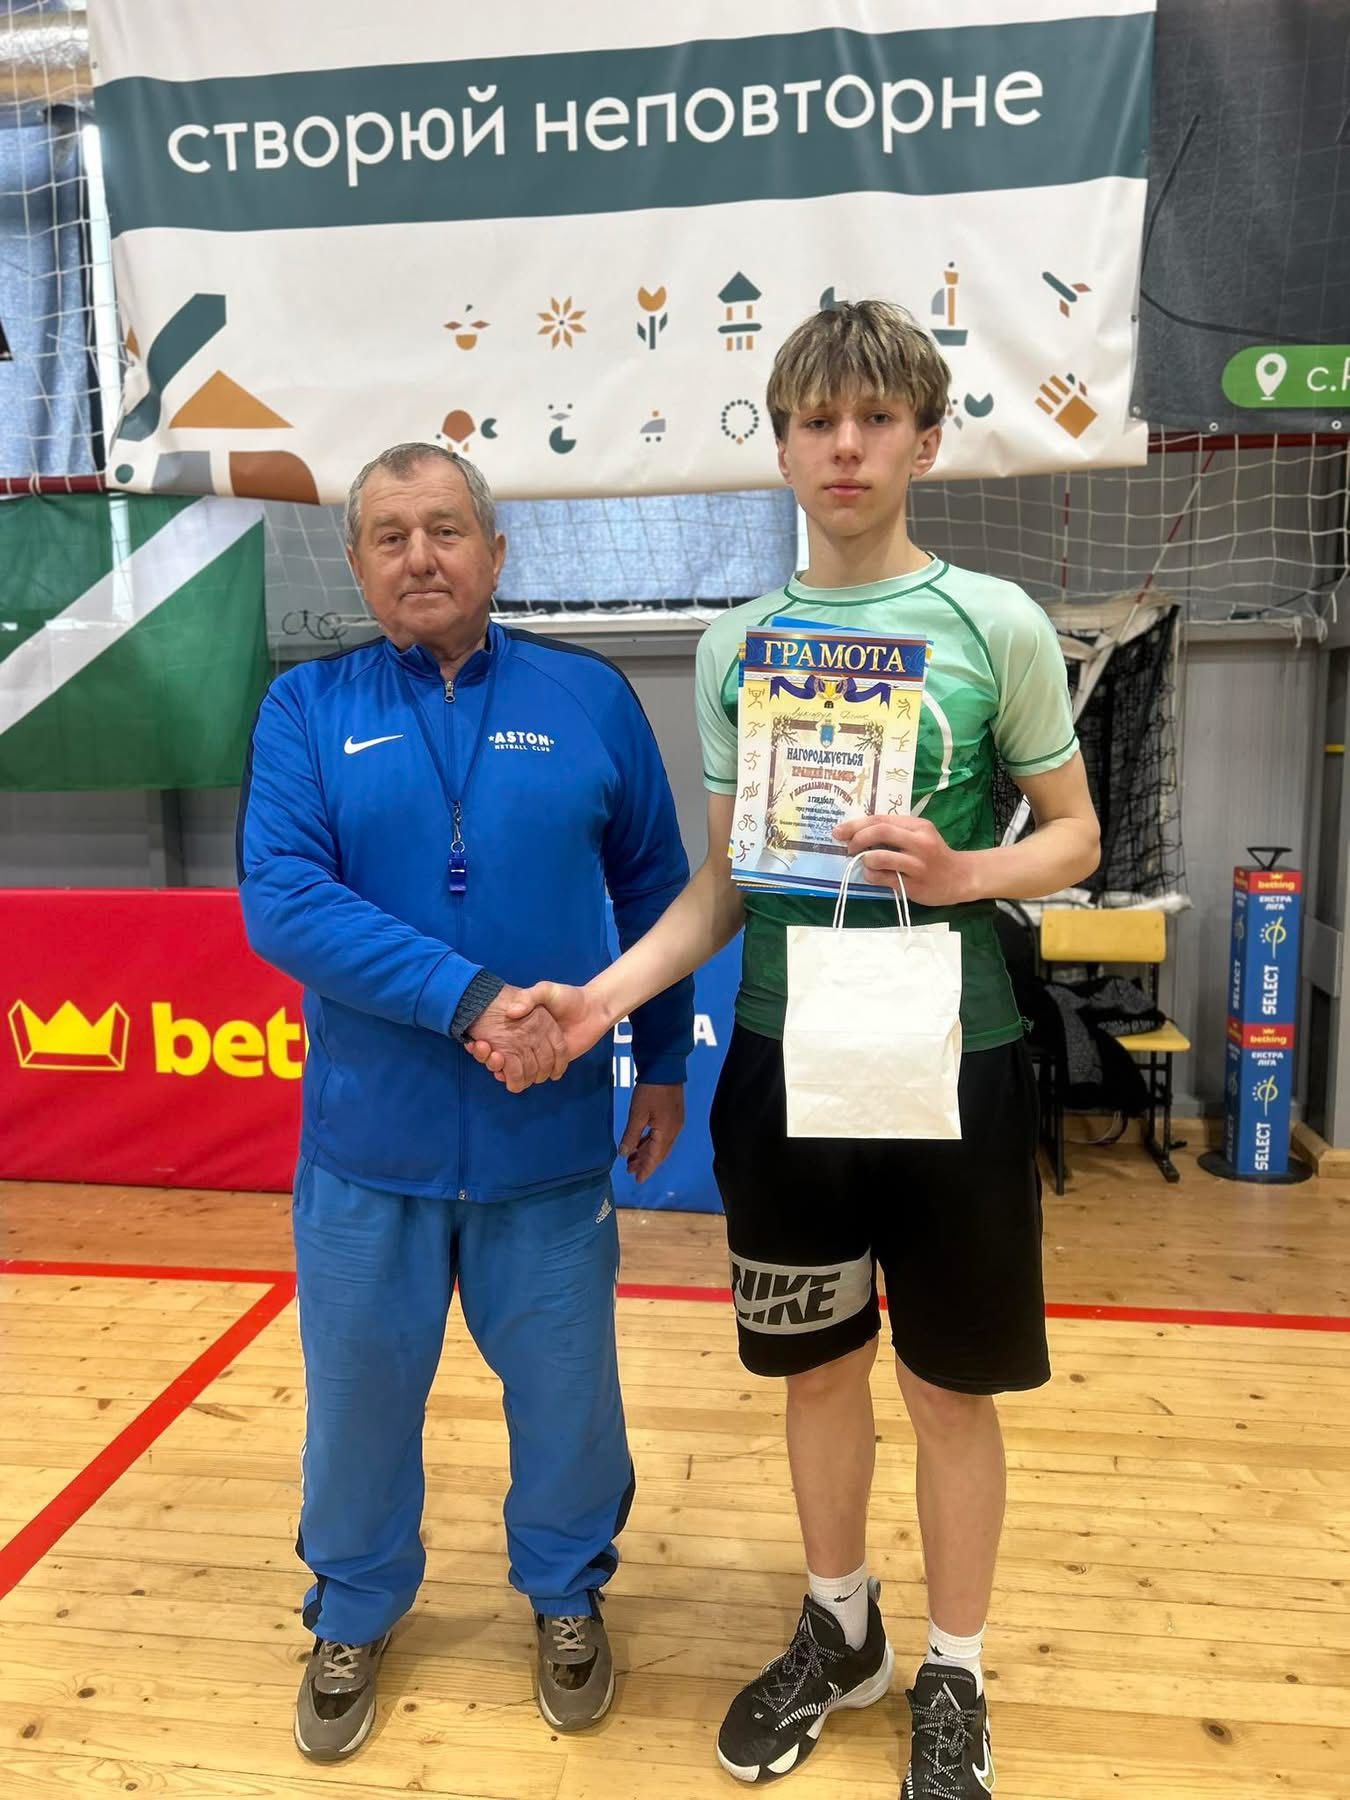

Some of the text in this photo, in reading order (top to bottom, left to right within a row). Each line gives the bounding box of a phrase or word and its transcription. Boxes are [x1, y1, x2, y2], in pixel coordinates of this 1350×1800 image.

[167, 69, 1044, 187] створюй неповторне
[763, 640, 906, 673] ГРАМОТА
[494, 731, 549, 746] ASTON
[787, 747, 864, 767] НАГОРОДЖУЄТЬСЯ
[1261, 965, 1279, 1016] SELECT
[152, 1002, 309, 1079] bet
[1250, 1035, 1287, 1045] betking
[1251, 1051, 1284, 1059] ЕКСТРА
[1254, 1122, 1271, 1171] SELECT
[732, 1262, 841, 1325] NIKE
